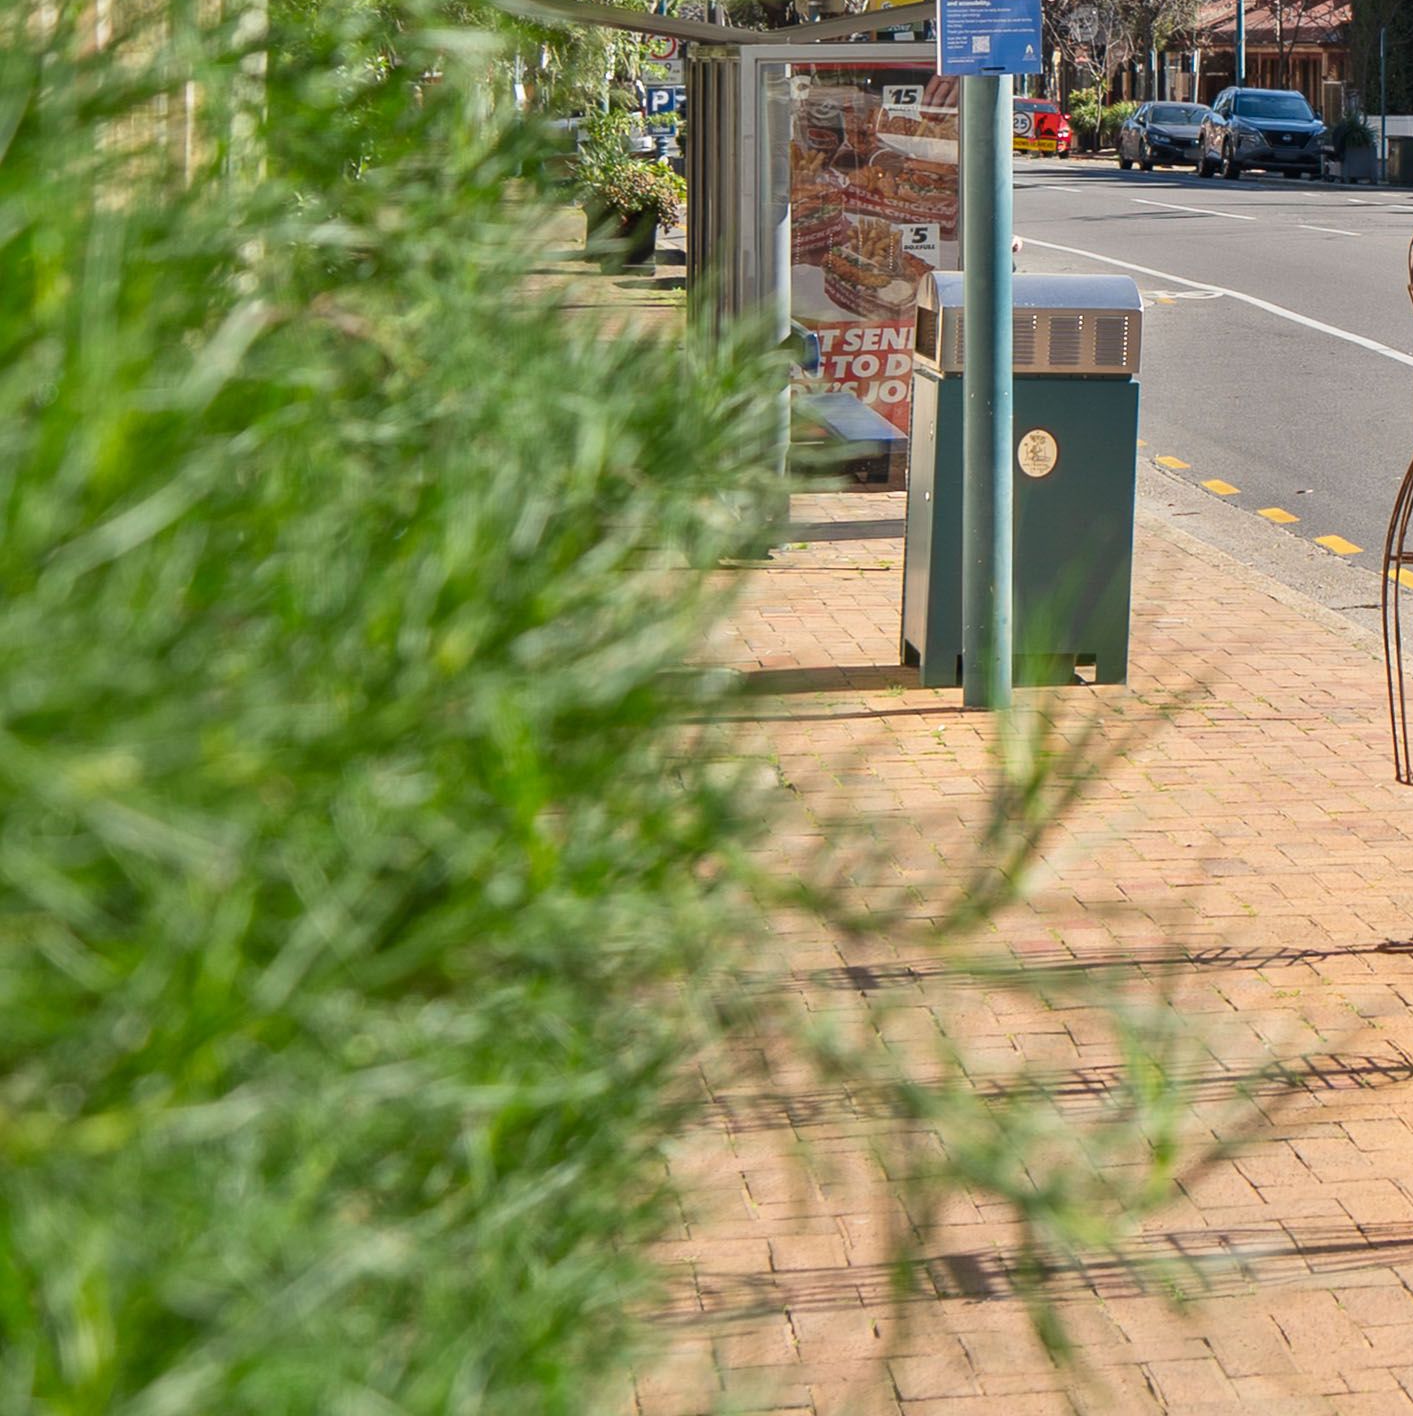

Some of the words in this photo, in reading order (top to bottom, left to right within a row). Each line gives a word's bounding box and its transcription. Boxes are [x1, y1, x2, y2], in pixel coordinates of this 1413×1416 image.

[652, 90, 669, 112] P
[1013, 118, 1028, 129] 25
[832, 354, 881, 378] TO
